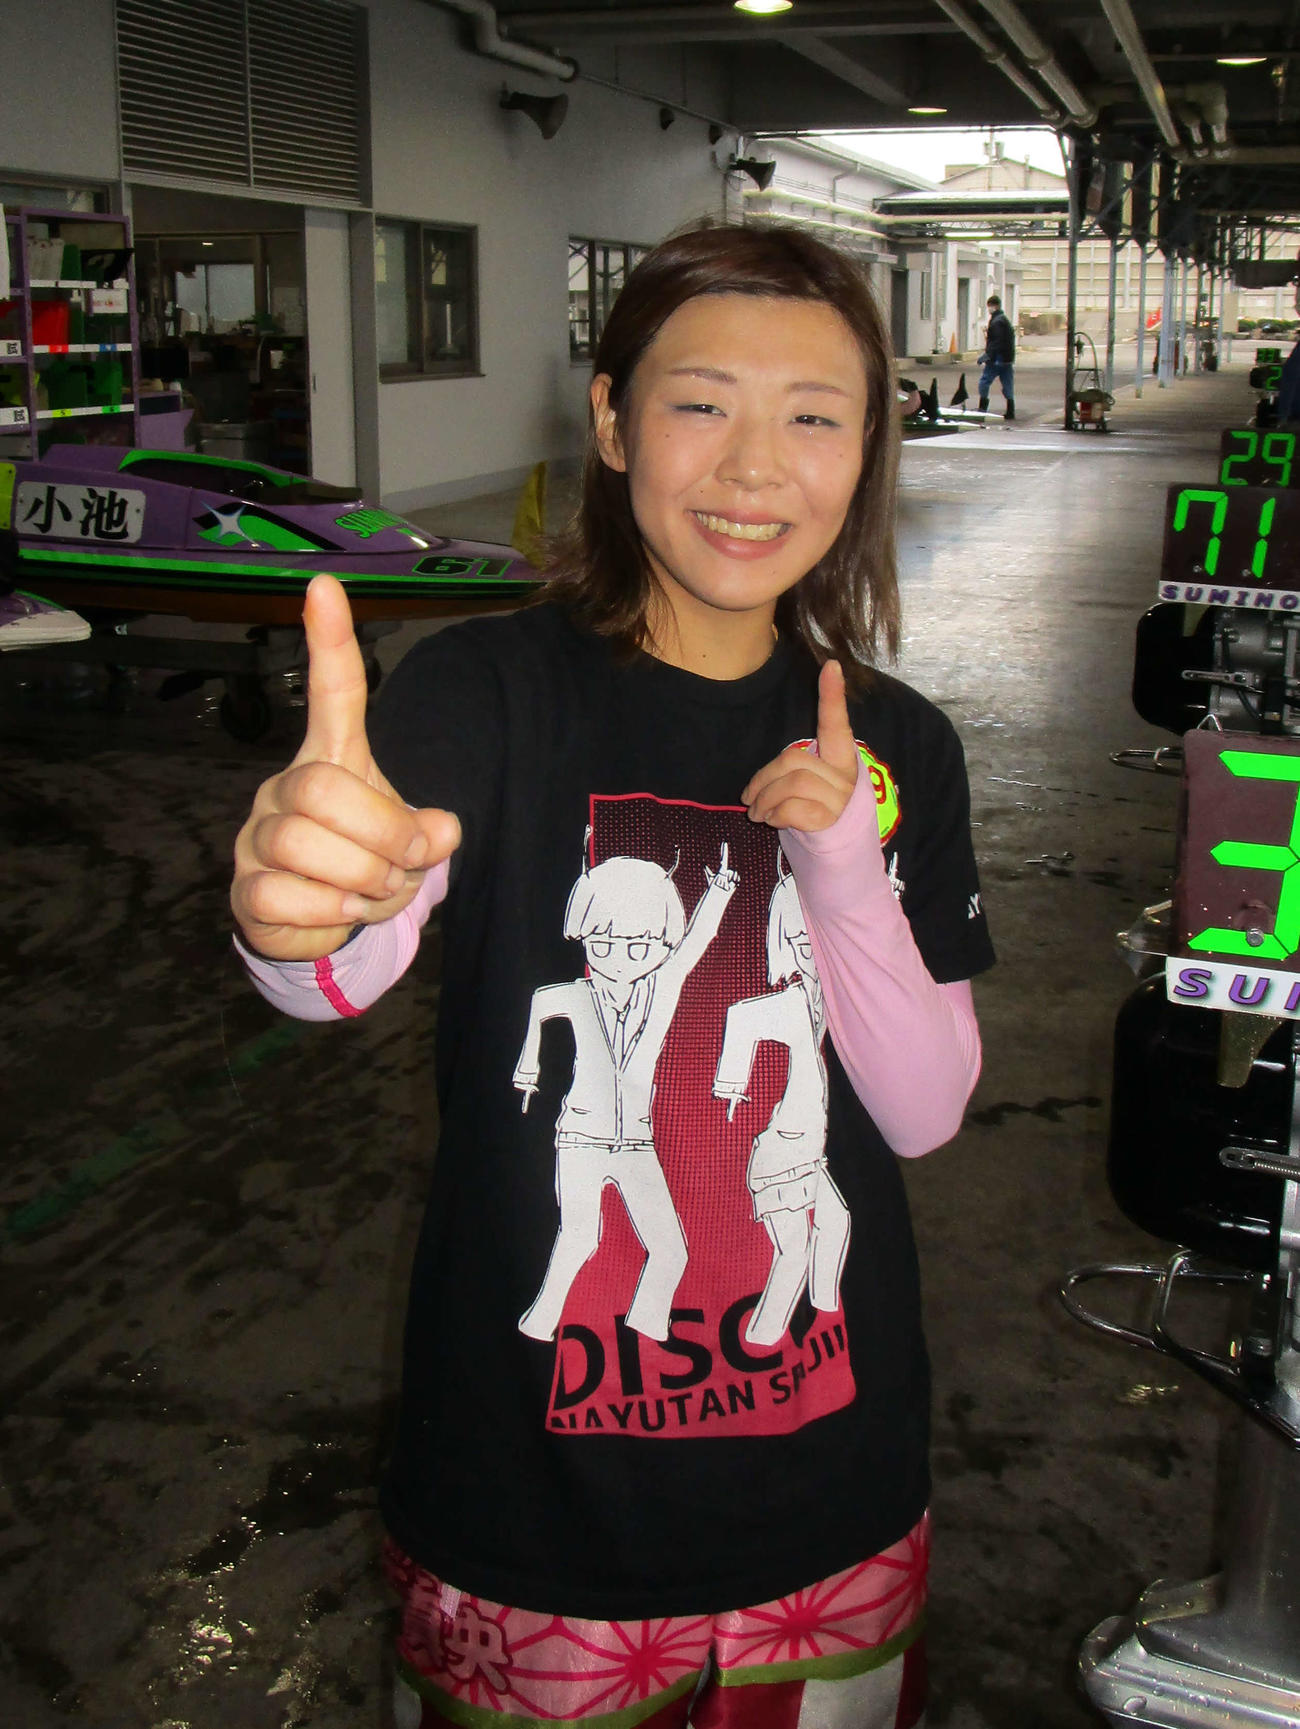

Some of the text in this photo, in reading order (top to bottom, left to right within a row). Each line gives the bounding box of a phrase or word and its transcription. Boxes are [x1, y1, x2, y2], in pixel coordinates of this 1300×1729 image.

[1220, 430, 1296, 487] 29
[22, 485, 129, 540] 小池
[1172, 489, 1276, 579] 71
[411, 555, 513, 577] 61
[1161, 584, 1300, 610] SUMINO
[1187, 750, 1300, 961] 3
